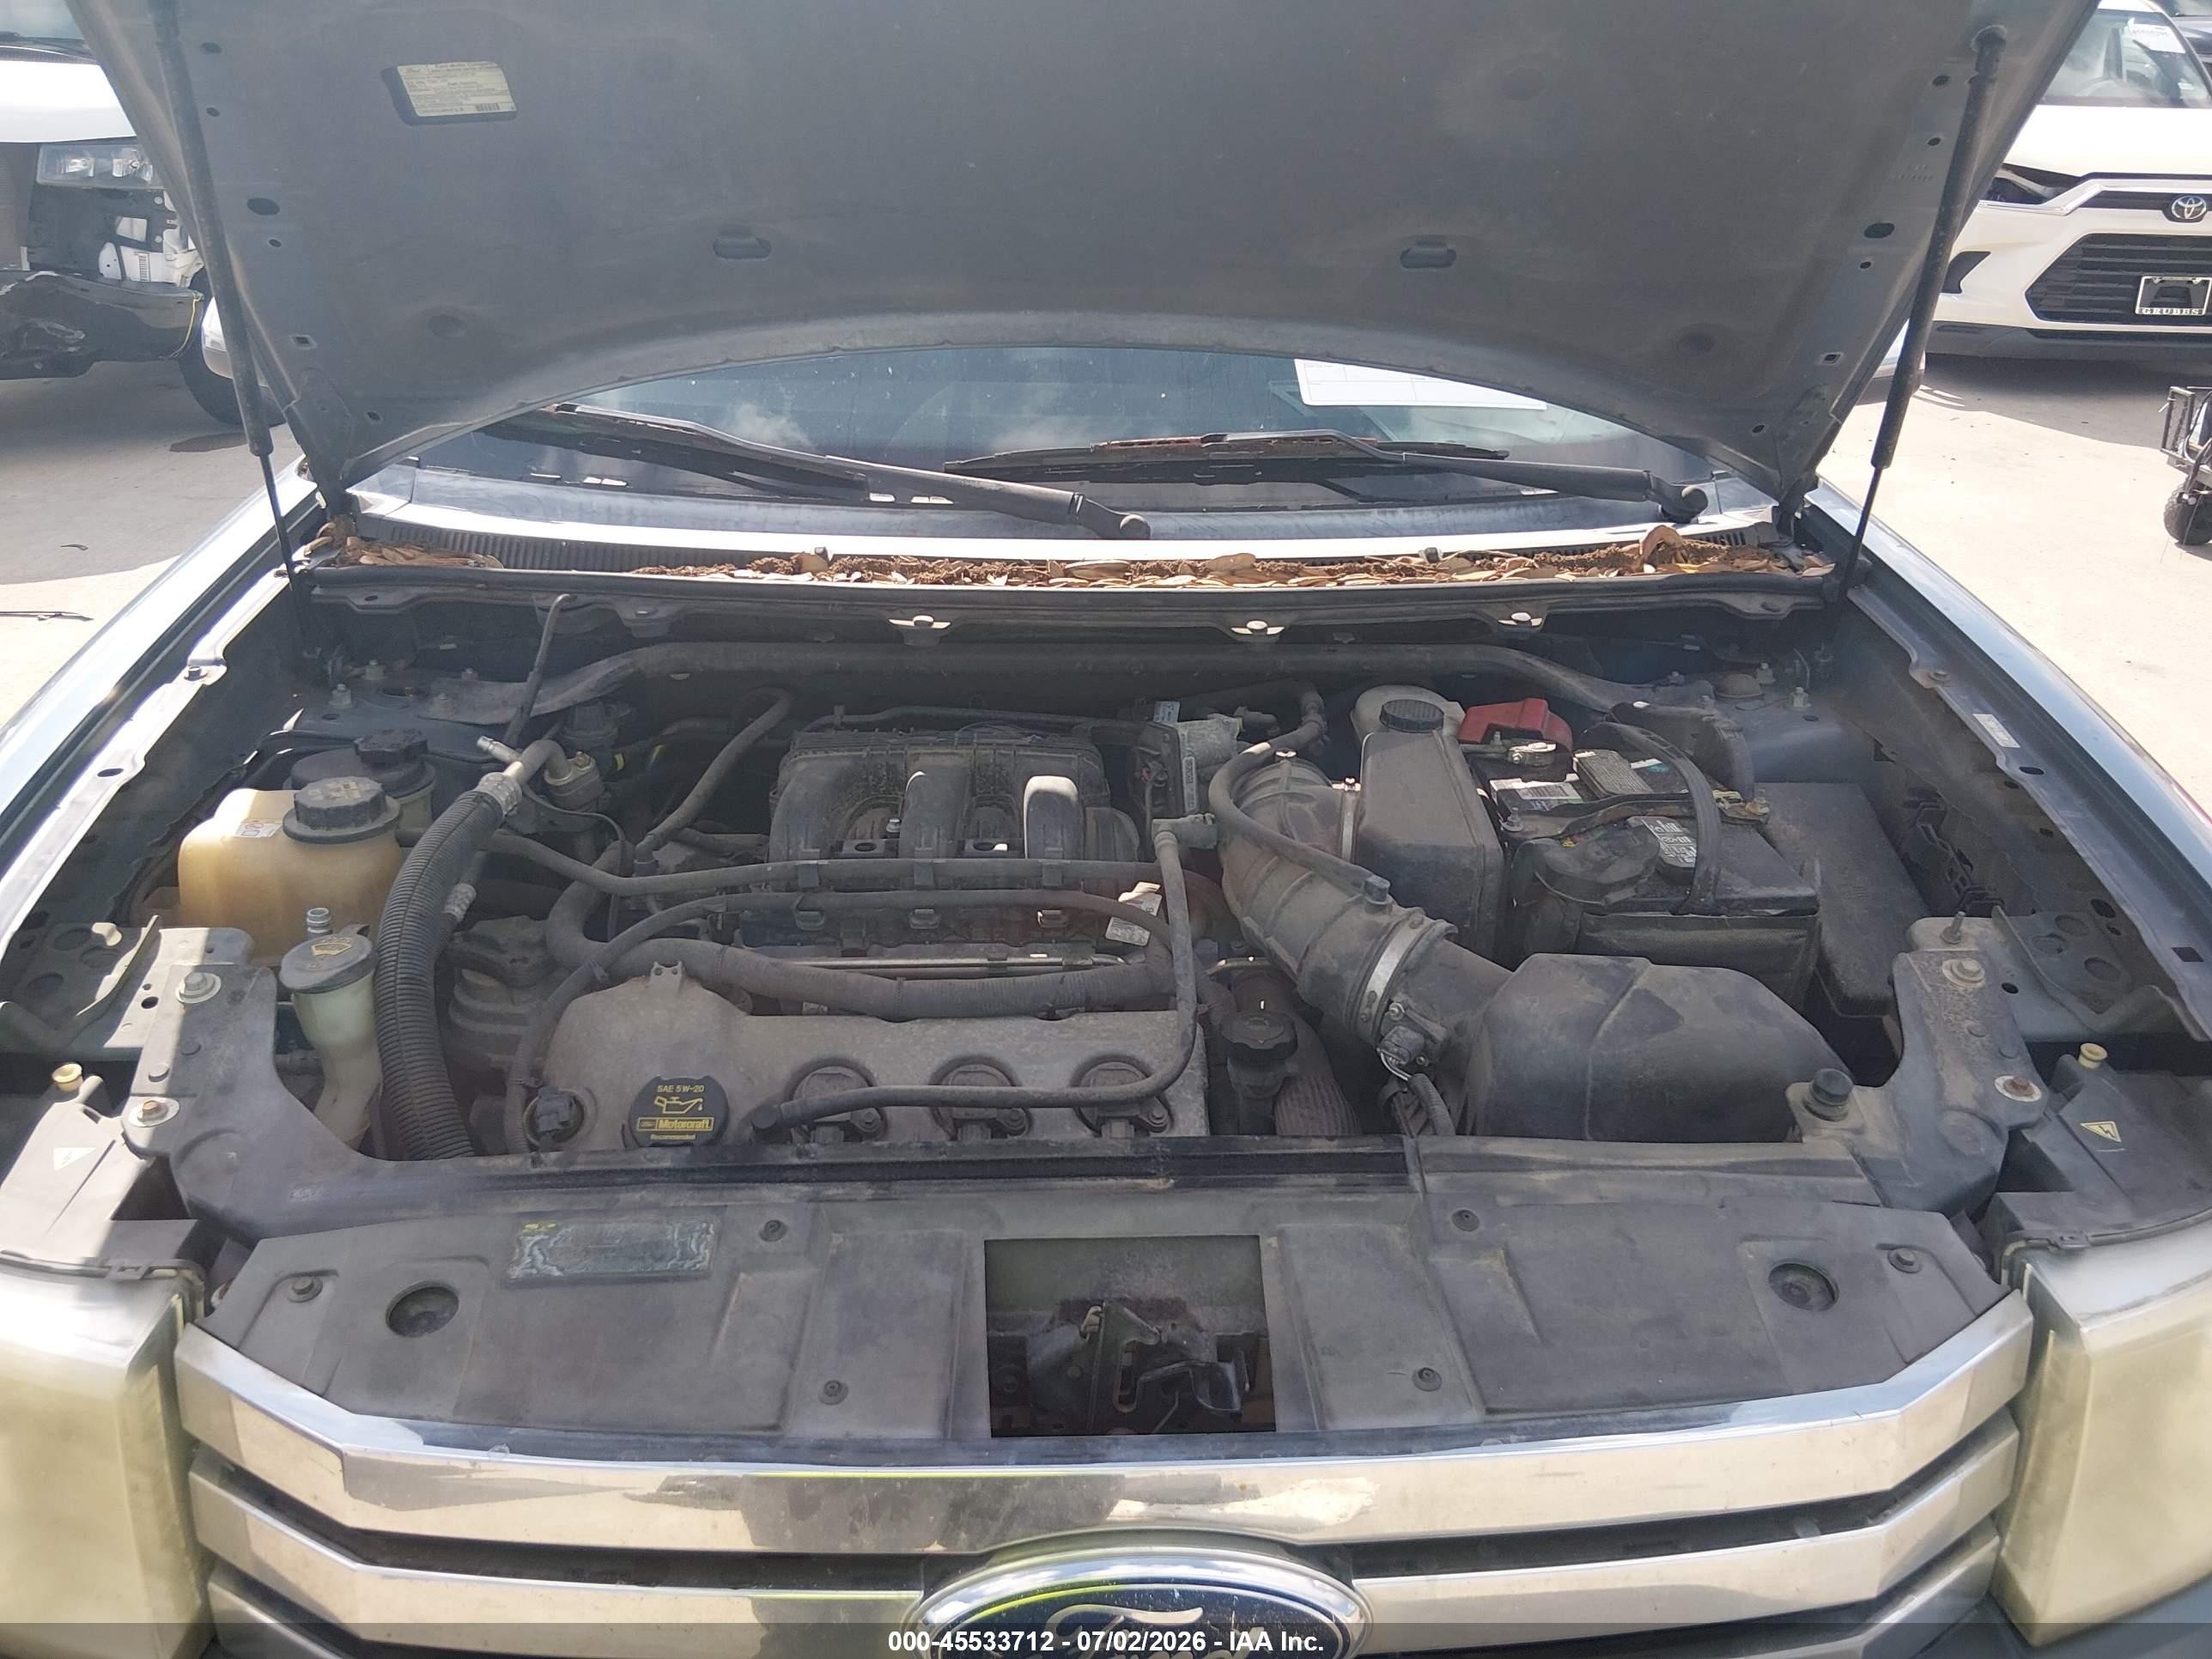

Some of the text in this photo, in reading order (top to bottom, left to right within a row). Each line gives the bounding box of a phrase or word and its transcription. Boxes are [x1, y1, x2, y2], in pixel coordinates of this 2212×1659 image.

[657, 1085, 705, 1093] SAE 5W-20
[659, 1119, 710, 1129] Motorcraft
